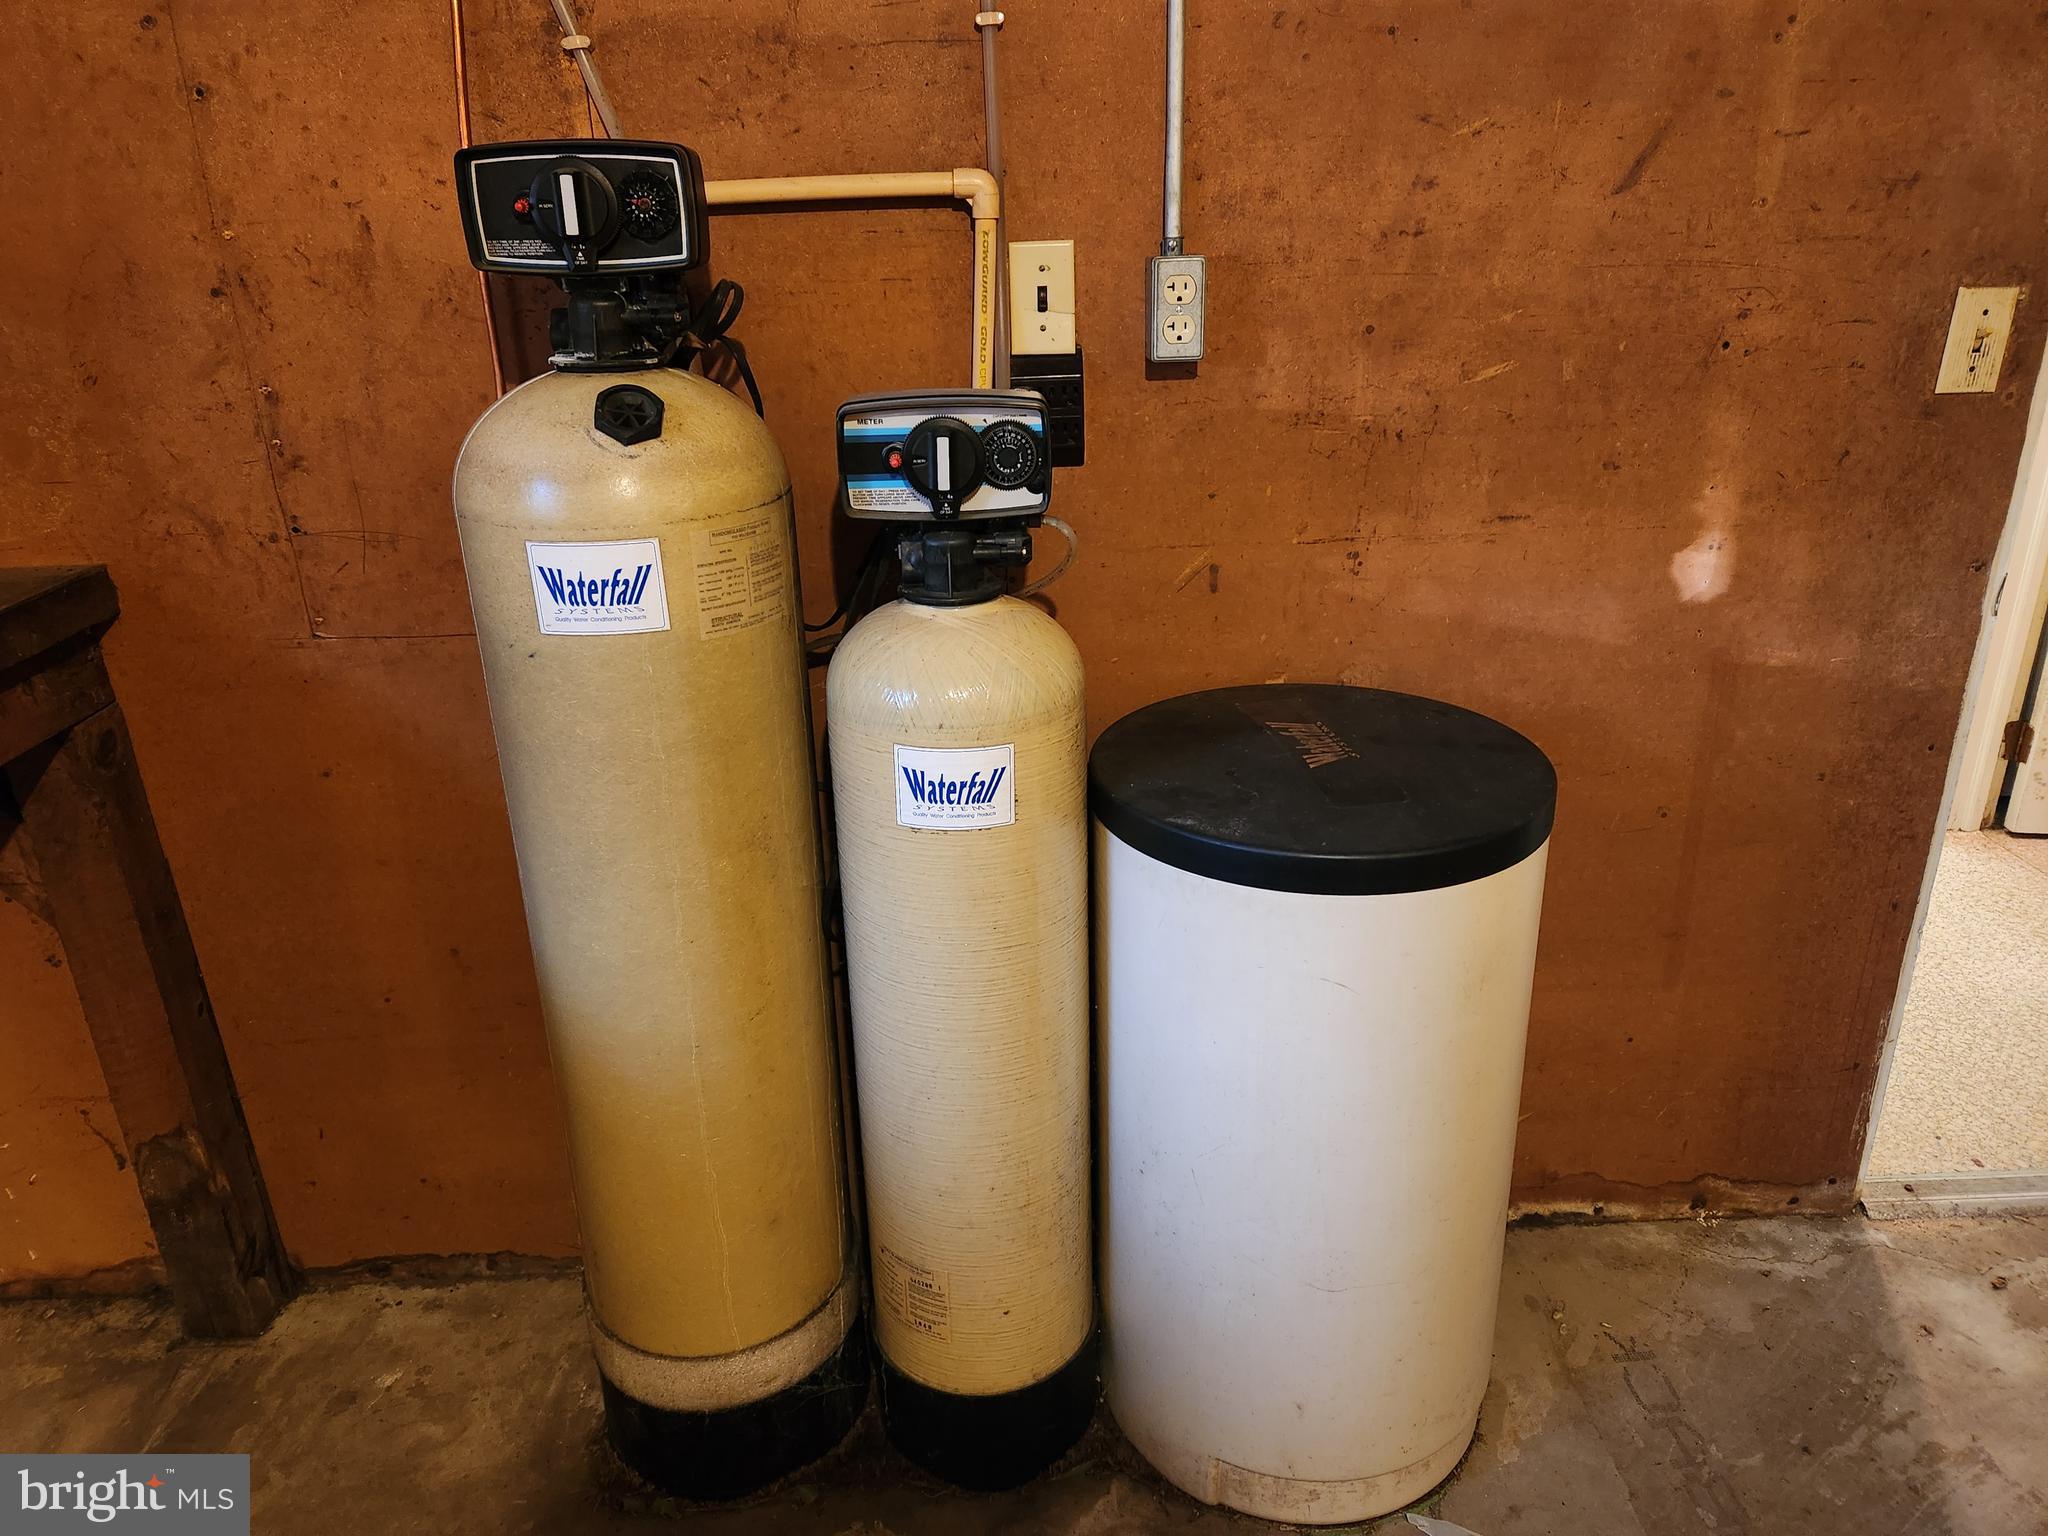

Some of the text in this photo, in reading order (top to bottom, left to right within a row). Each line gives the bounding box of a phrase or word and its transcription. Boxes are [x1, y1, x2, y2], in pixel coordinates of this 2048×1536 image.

[980, 326, 988, 364] GOLD
[537, 563, 652, 607] Waterfall
[554, 606, 645, 615] SYSTEMS
[901, 766, 1007, 805] Waterfall
[912, 804, 996, 812] SYSTEMS
